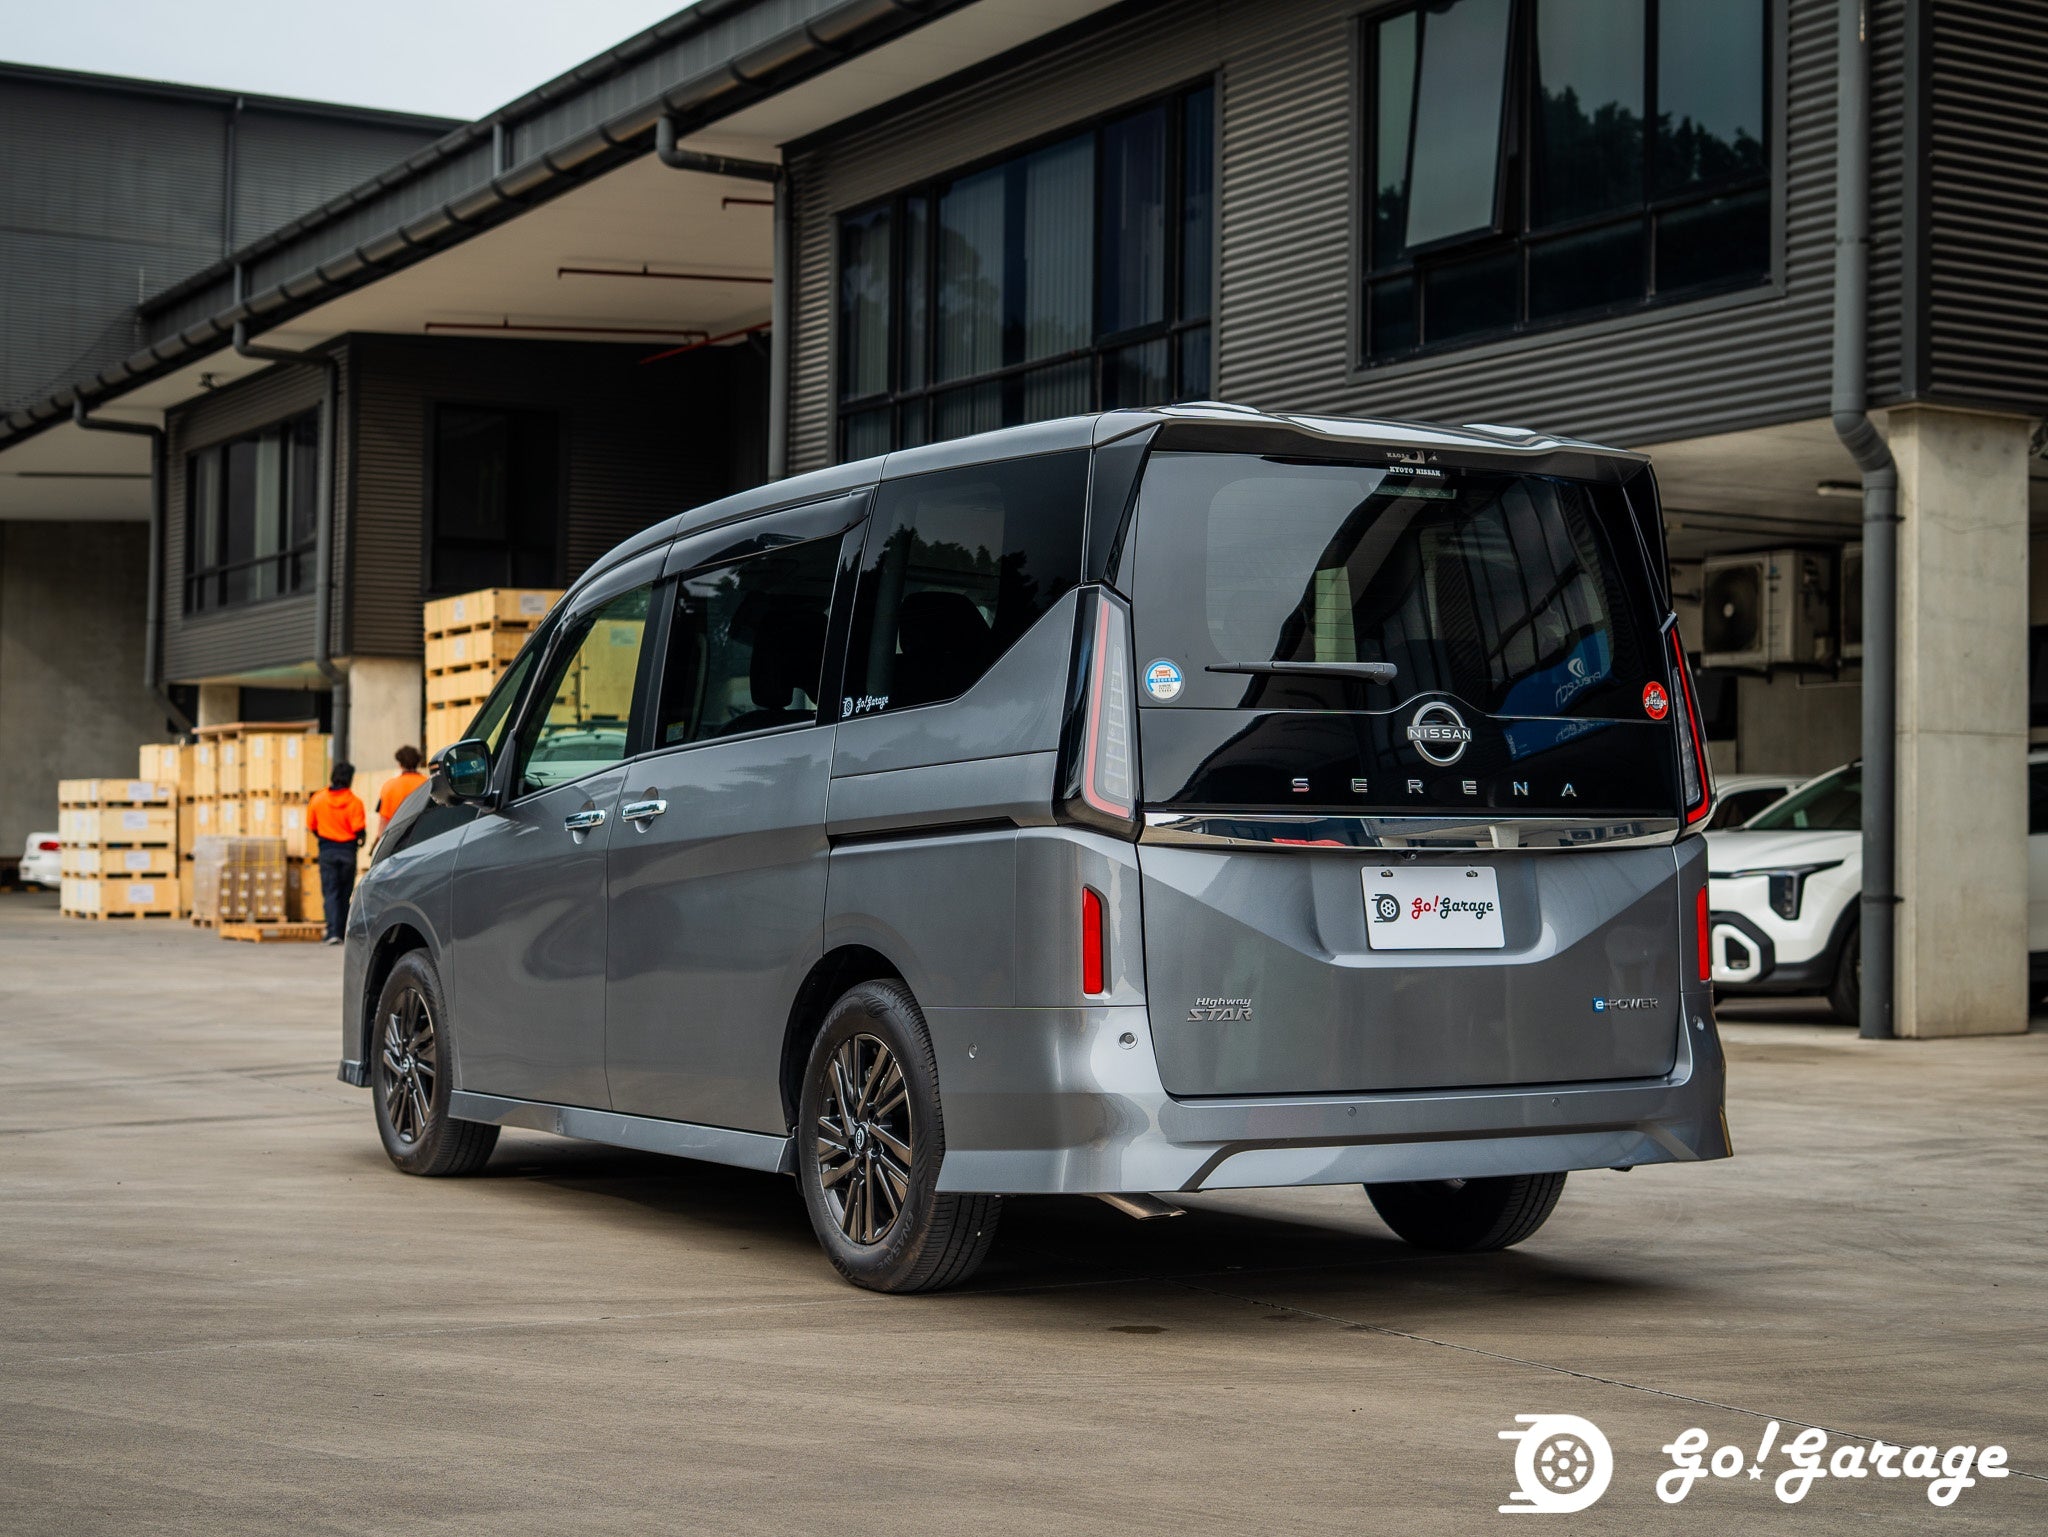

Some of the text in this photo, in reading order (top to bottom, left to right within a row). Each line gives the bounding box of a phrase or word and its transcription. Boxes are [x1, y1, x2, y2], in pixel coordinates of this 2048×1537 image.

[1389, 466, 1441, 477] KYOTO NISSAN
[1409, 728, 1471, 740] NISSAN
[1291, 777, 1578, 798] SERENA
[1411, 895, 1495, 920] Go!Garage
[1195, 997, 1252, 1009] Highway
[1593, 997, 1659, 1011] e-POWER
[1186, 1007, 1253, 1022] STAR
